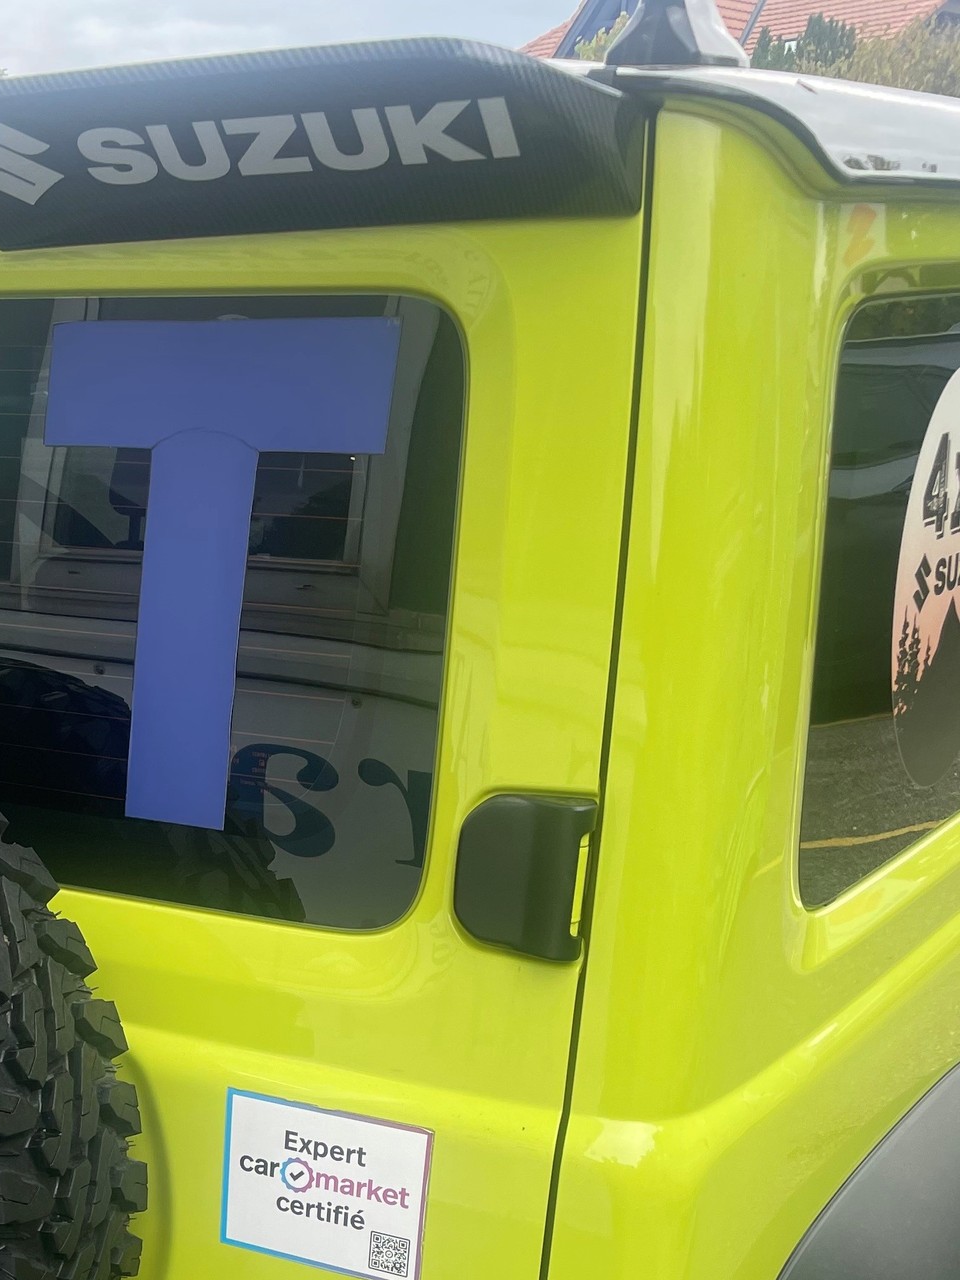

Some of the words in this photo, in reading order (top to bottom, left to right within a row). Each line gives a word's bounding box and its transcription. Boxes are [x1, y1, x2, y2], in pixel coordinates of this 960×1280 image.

[76, 97, 521, 186] SUZUKI
[933, 552, 960, 597] SU
[284, 1129, 367, 1168] Expert
[276, 1195, 366, 1231] certifié
